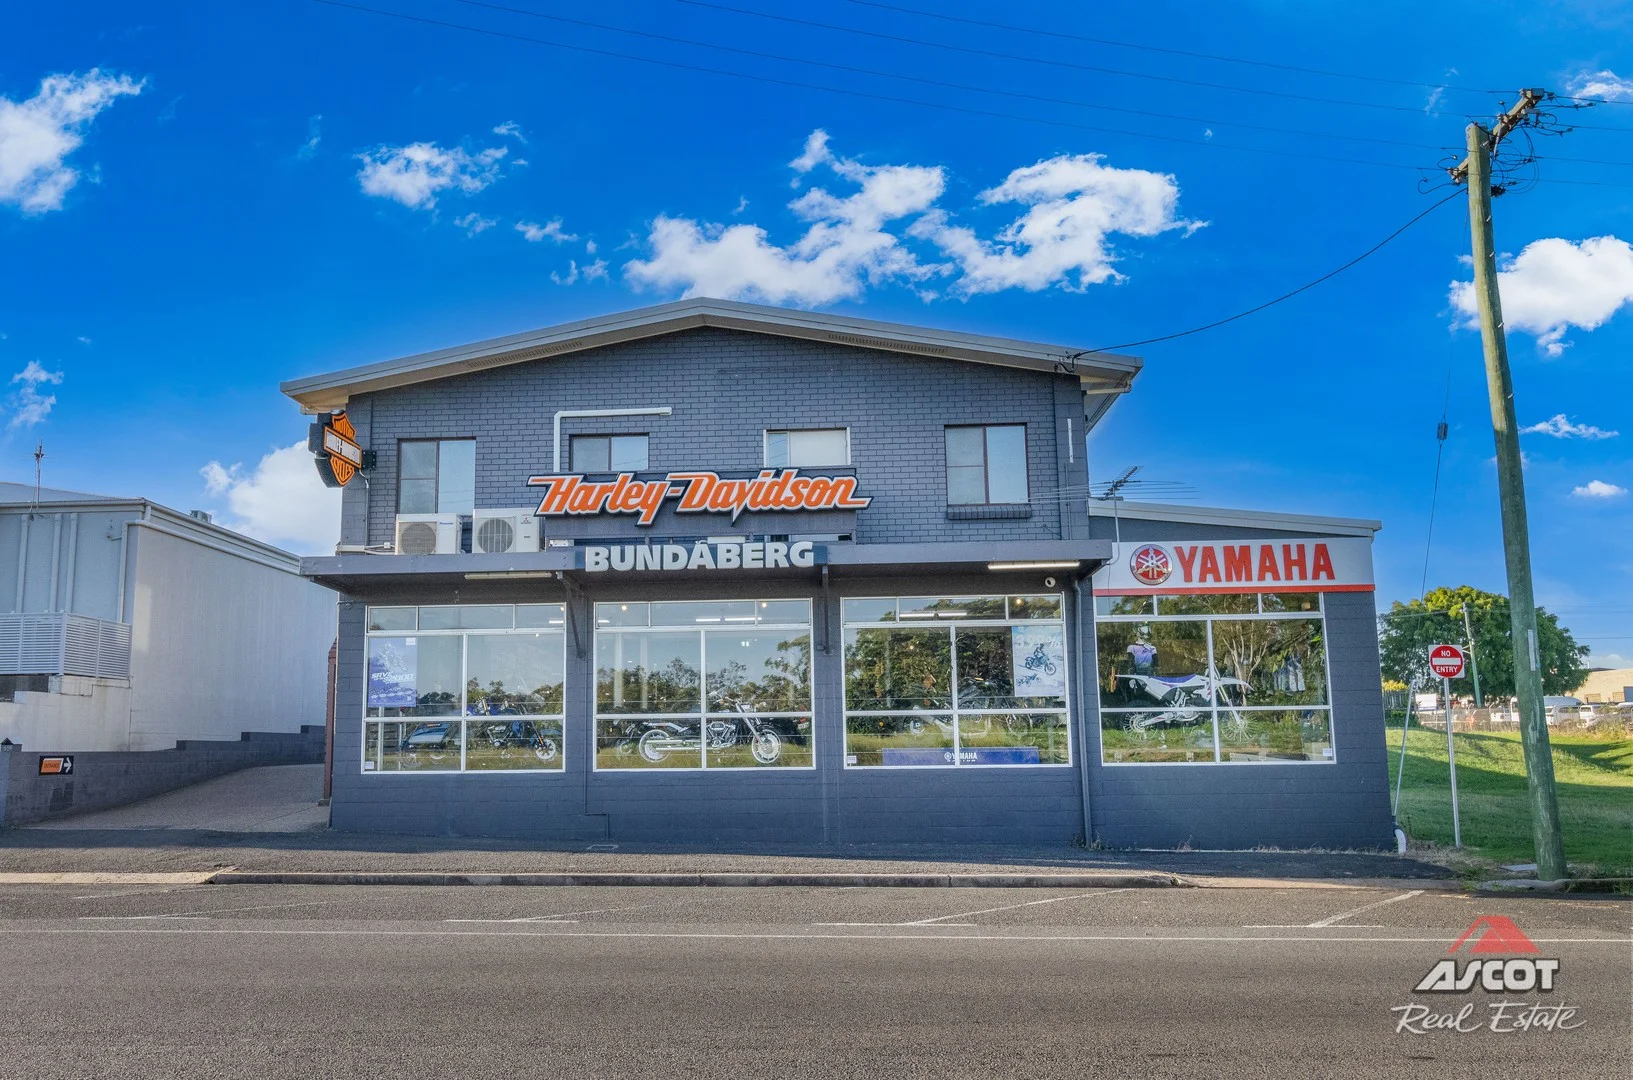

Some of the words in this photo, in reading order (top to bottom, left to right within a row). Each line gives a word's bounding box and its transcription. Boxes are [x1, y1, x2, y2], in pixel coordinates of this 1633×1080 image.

[528, 468, 871, 526] Harley-Davidson
[585, 541, 815, 572] BUNDABERG
[1174, 543, 1336, 583] YAMAHA
[1436, 665, 1458, 673] ENTRY
